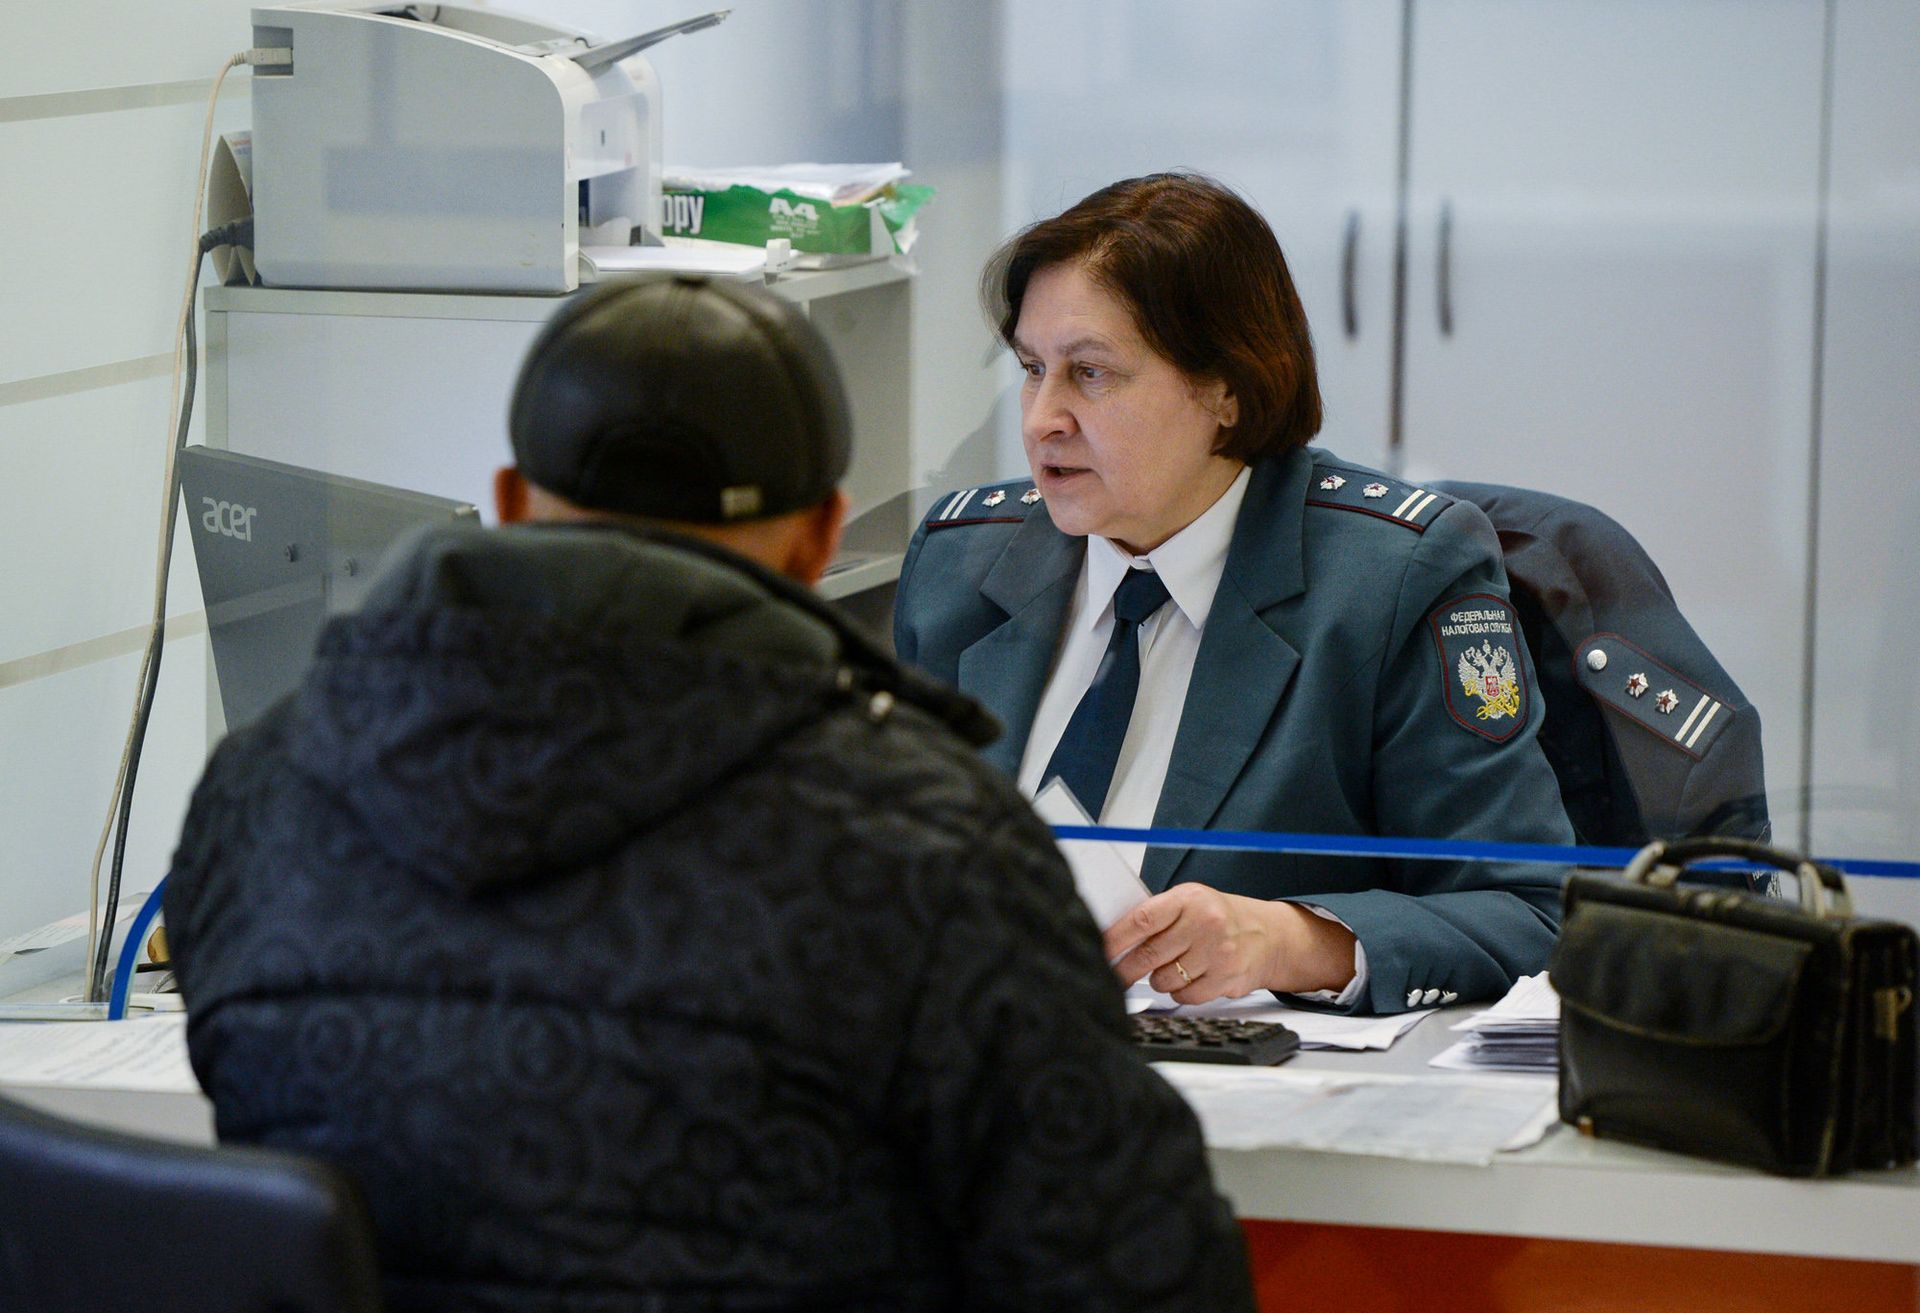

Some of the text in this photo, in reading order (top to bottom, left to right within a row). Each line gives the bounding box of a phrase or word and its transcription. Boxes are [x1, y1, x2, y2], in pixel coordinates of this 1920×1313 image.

[769, 197, 819, 221] A4
[202, 496, 257, 542] acer
[1450, 610, 1506, 623] ФЕДЕРАЛЬНАЯ
[1441, 623, 1490, 636] НАЛОГОВАЯ
